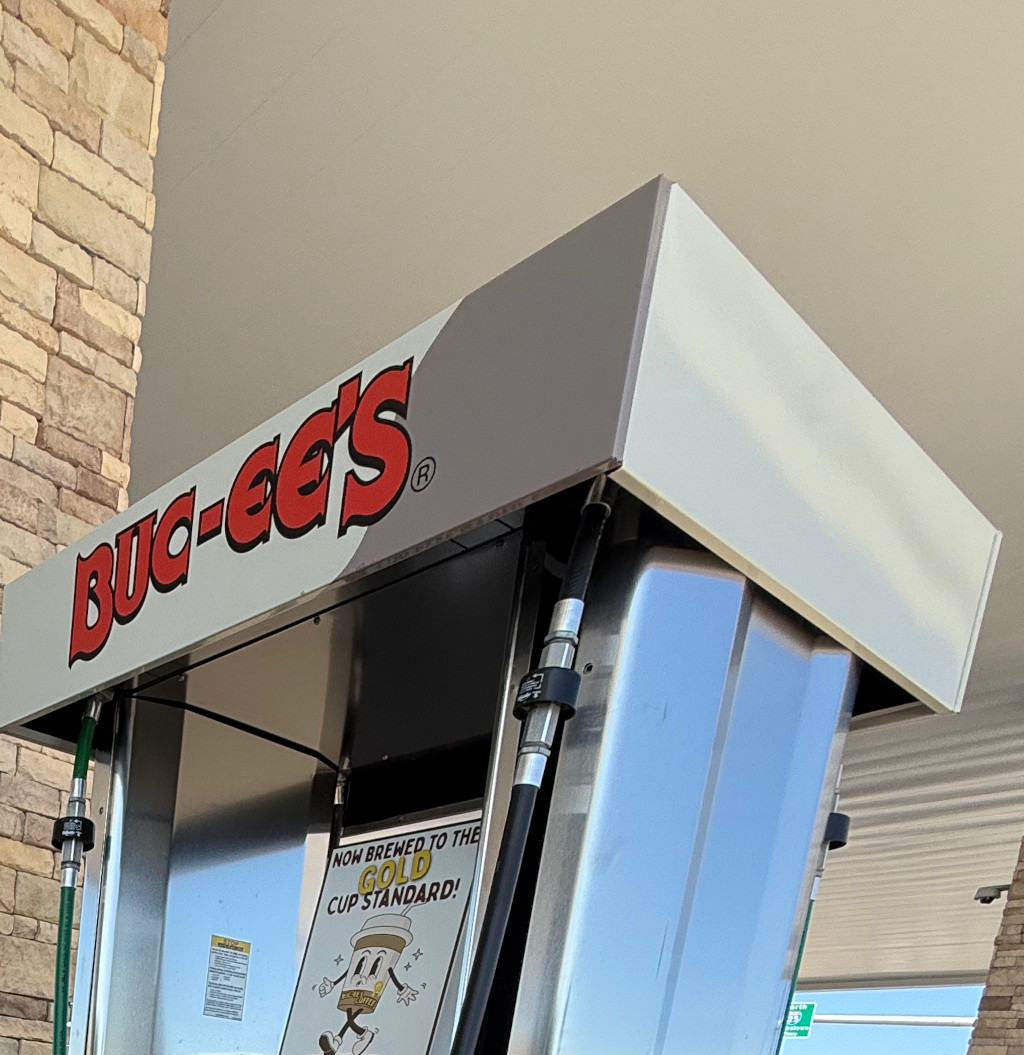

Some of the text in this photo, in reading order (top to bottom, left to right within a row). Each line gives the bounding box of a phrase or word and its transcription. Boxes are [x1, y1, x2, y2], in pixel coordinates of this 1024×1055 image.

[332, 826, 481, 868] NOW BREWED TO THE
[358, 849, 432, 894] GOLD
[327, 878, 461, 915] CUP STANDARD!
